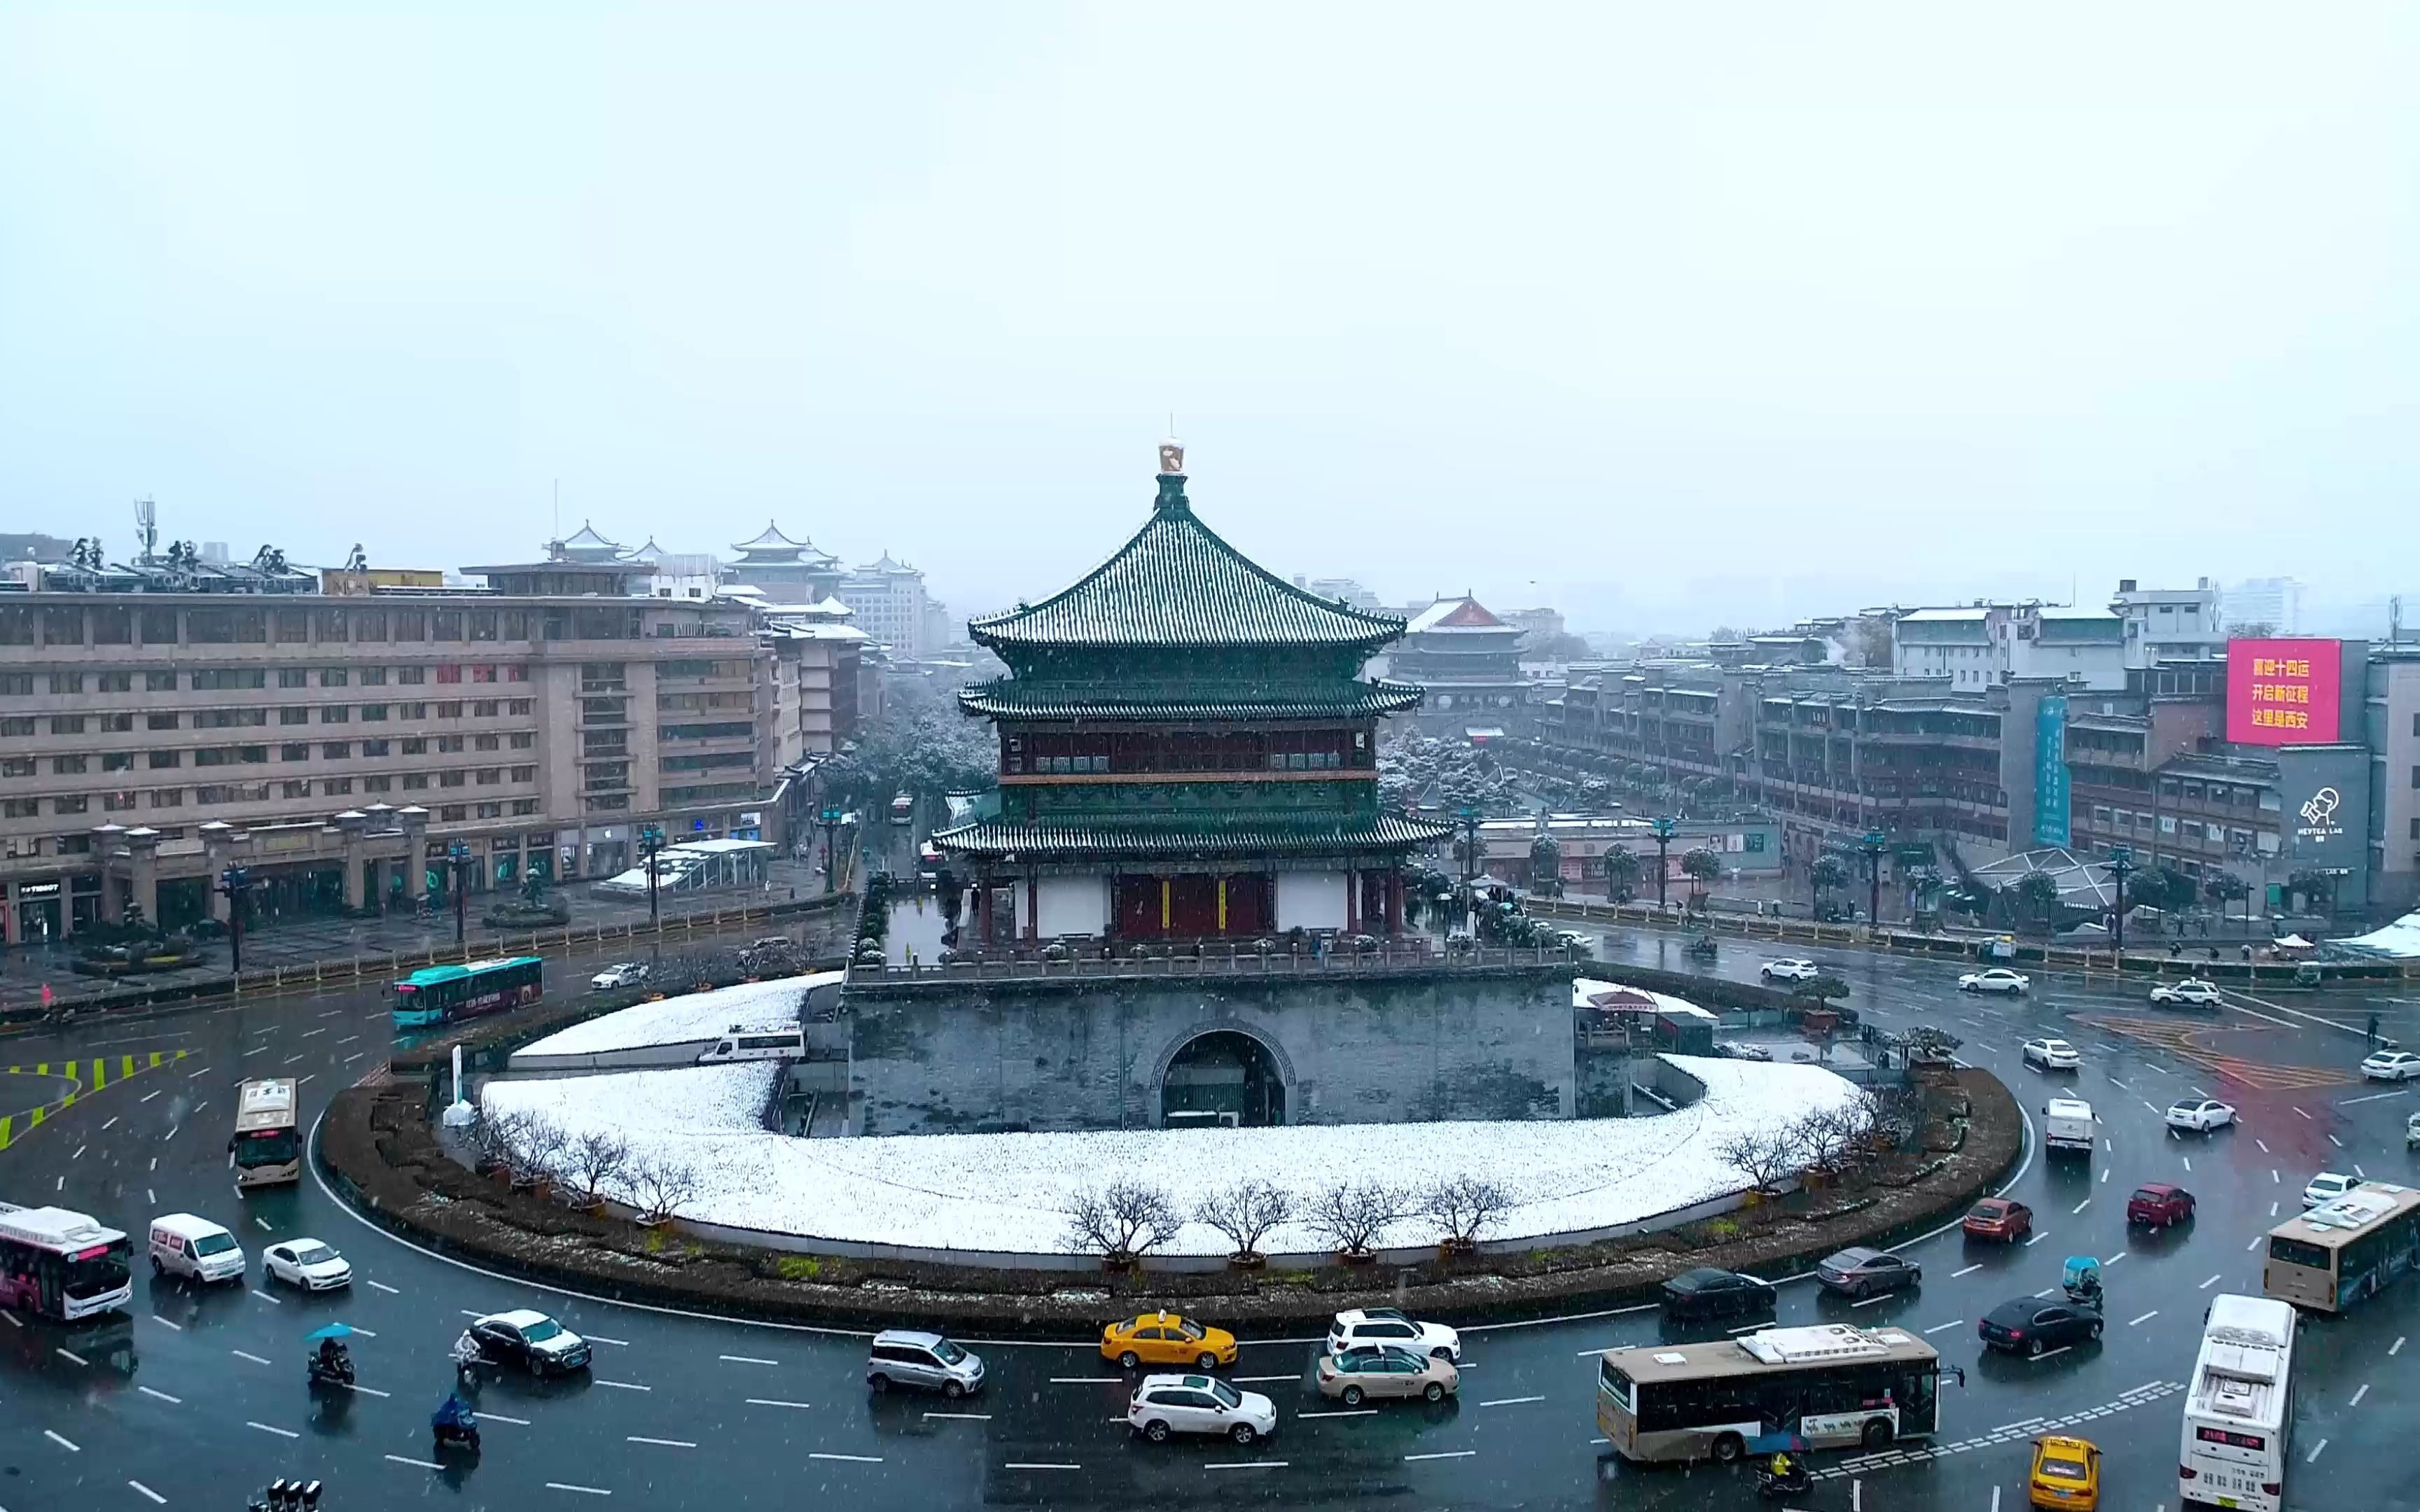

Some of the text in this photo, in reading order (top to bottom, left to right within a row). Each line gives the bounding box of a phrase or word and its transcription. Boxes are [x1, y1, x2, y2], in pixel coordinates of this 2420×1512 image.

[2253, 658, 2309, 678] 喜迎十四运
[2252, 684, 2309, 704] 开启新征程
[2252, 708, 2308, 729] 这里是西安
